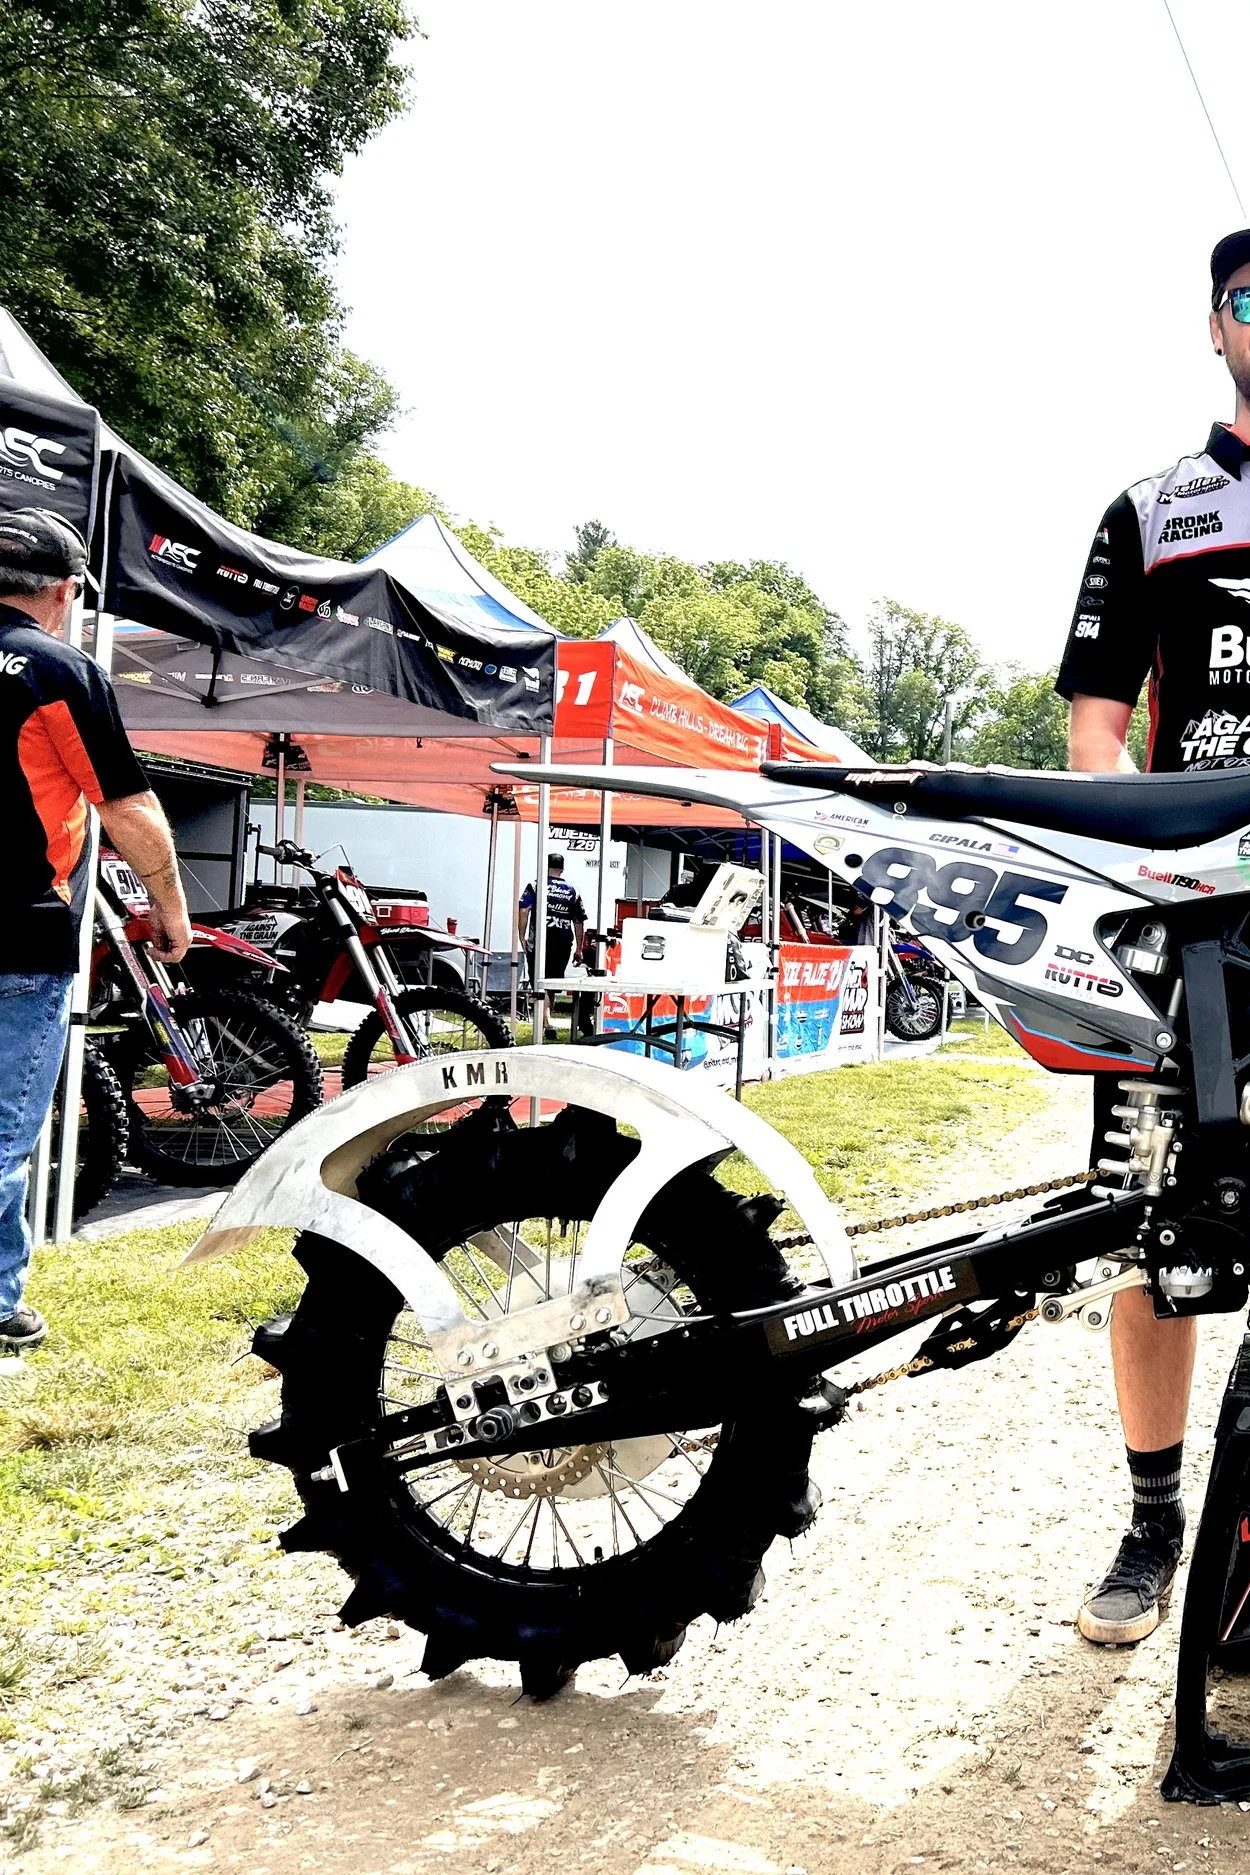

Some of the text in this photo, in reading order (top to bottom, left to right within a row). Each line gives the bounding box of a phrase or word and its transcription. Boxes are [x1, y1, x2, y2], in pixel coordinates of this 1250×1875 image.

[0, 427, 67, 481] SC
[14, 471, 56, 491] CANOPIES
[1163, 510, 1220, 530] BRONK
[1158, 521, 1223, 544] RACING
[1075, 621, 1100, 639] 914
[650, 696, 677, 724] CLIMB
[679, 708, 704, 734] HILLS
[708, 720, 737, 748] DREAM
[1180, 736, 1240, 762] THE
[830, 812, 870, 826] AMERICAN
[567, 839, 597, 851] 128
[929, 833, 993, 852] CIPALA
[852, 847, 1069, 966] 895
[243, 923, 277, 931] AGAINST
[254, 931, 278, 940] GRAIN
[1054, 944, 1095, 966] DC
[442, 1061, 508, 1090] KMR
[783, 1265, 957, 1341] FULL THROTTLE
[853, 1308, 899, 1335] Motor
